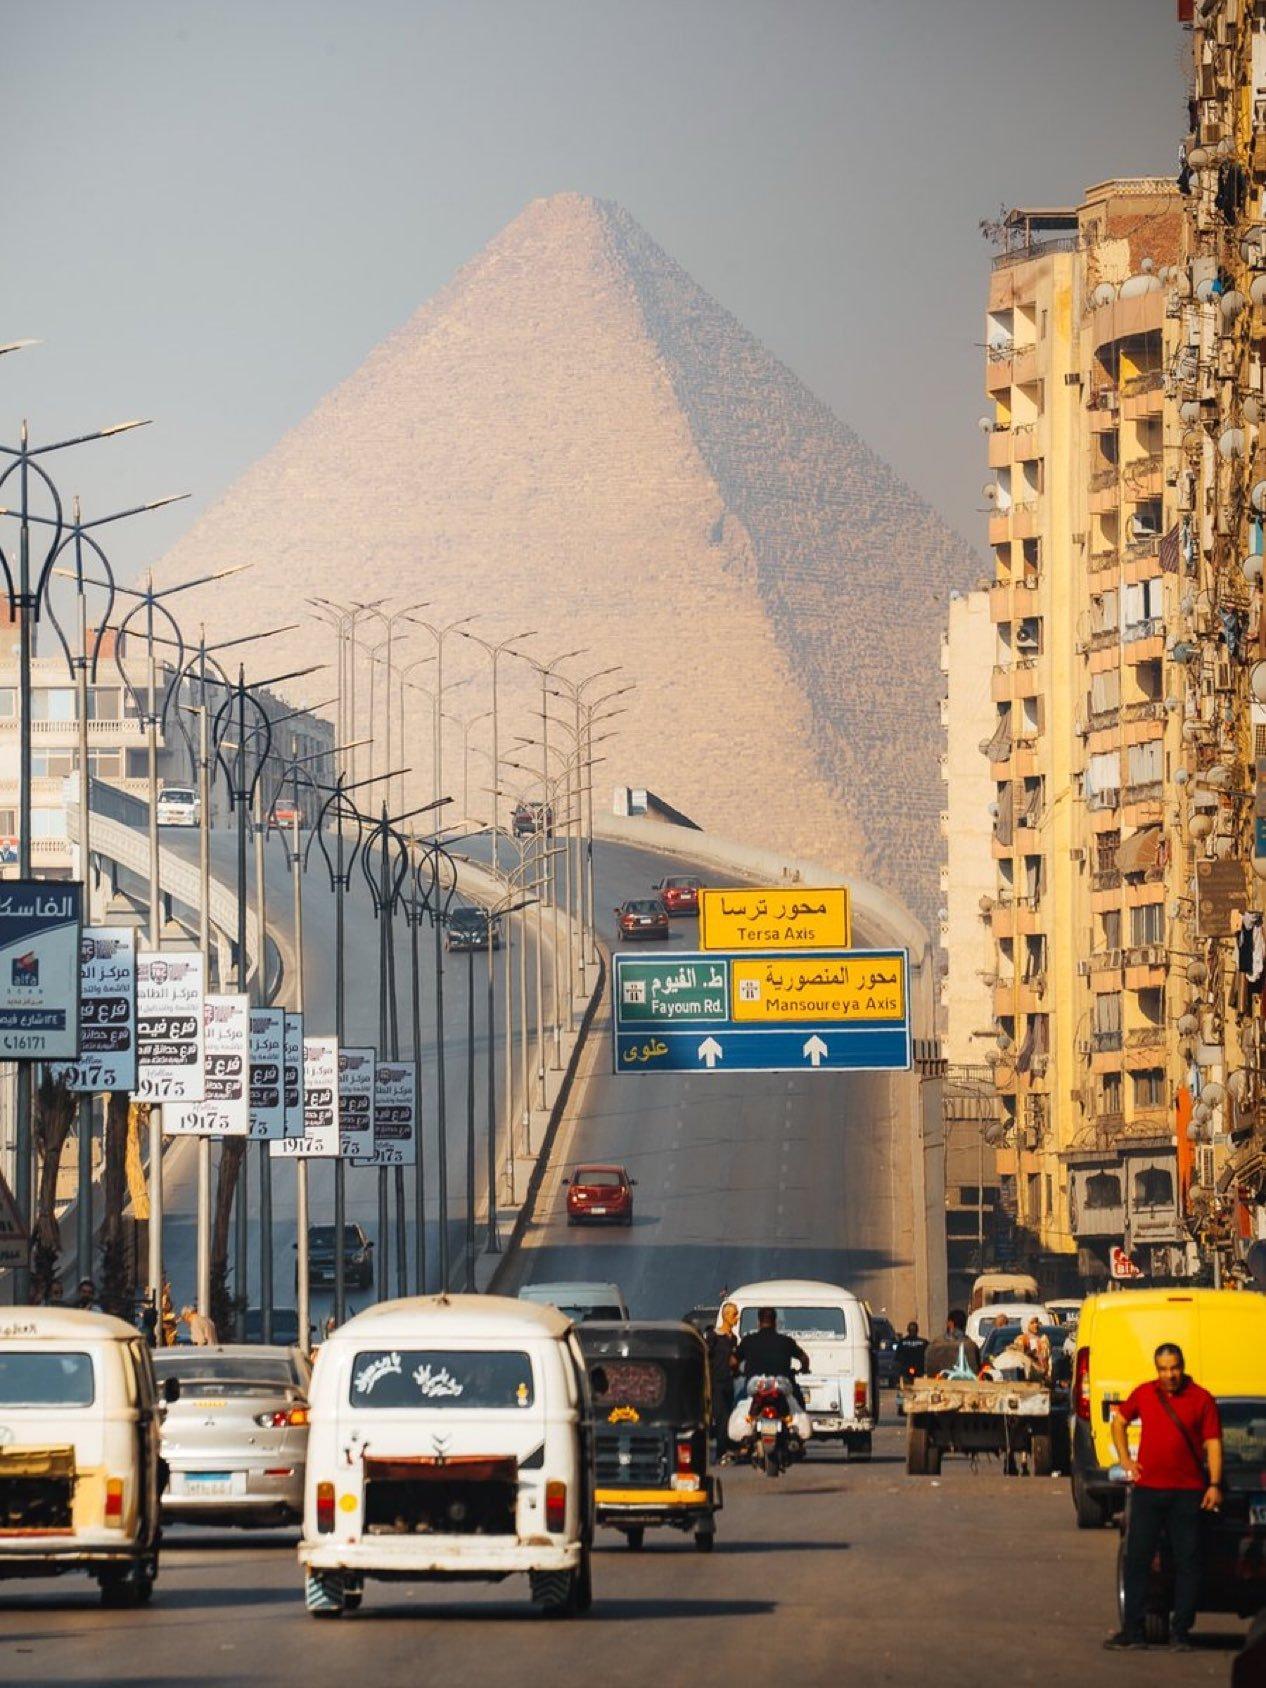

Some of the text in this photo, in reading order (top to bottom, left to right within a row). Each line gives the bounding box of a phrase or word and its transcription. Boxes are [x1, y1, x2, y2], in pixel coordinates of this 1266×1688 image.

[721, 897, 827, 921] محور ترسا
[737, 926, 815, 940] Tersa Axis
[651, 967, 697, 998] الفيوم
[766, 964, 897, 992] محور المنصورية
[652, 999, 723, 1018] Fayoum Rd.
[766, 996, 897, 1014] Mansoureya Axis
[169, 1018, 196, 1039] فرع
[13, 1036, 46, 1049] 16171
[214, 1057, 241, 1077] فرع
